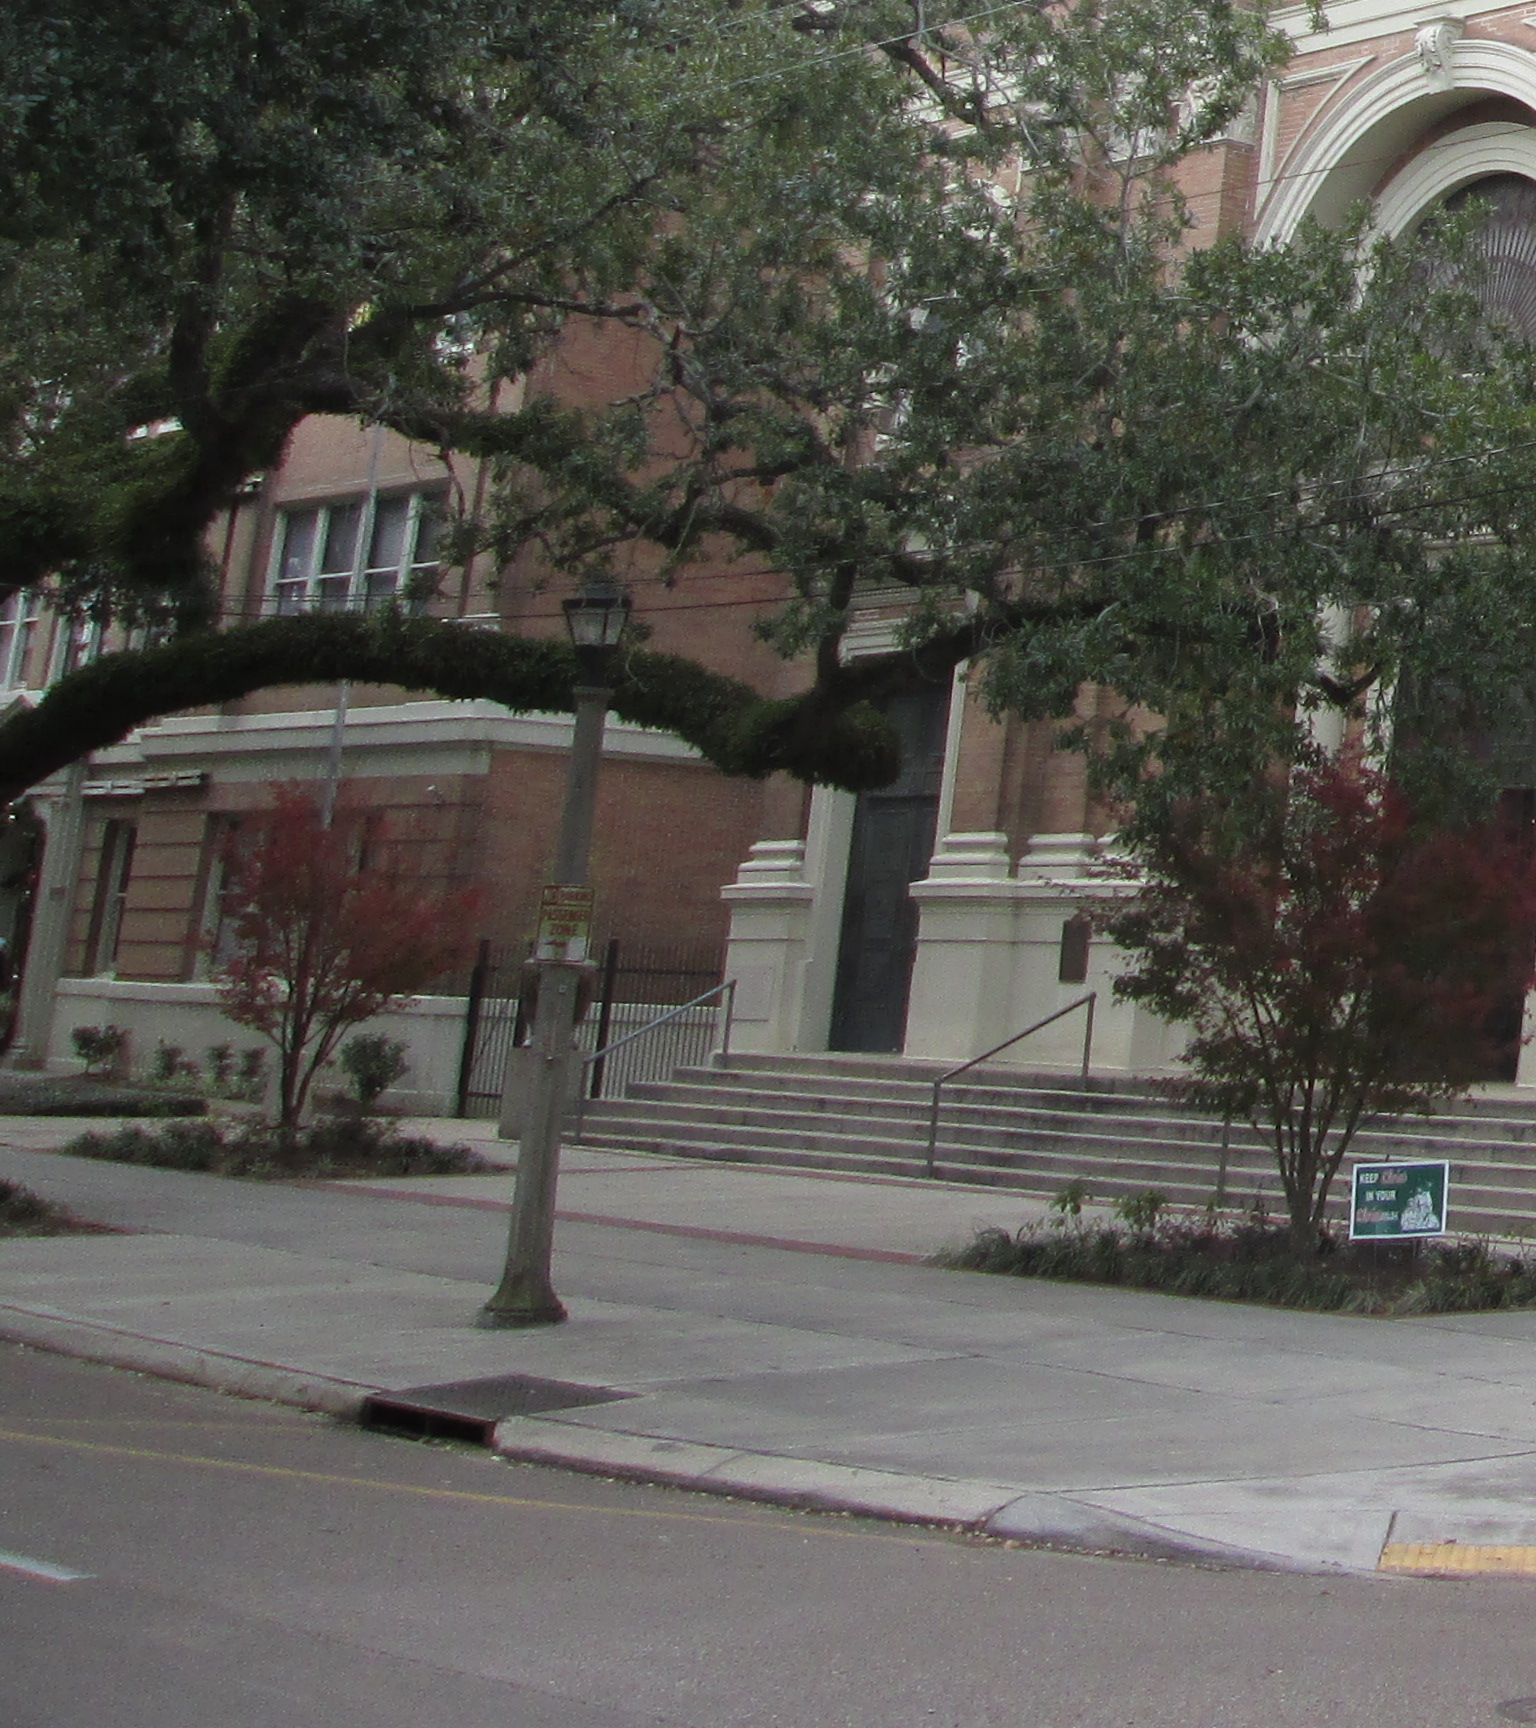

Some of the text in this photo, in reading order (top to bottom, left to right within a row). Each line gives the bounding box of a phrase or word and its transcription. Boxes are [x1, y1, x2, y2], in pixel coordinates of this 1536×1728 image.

[1359, 1172, 1379, 1184] KEEP
[1365, 1190, 1397, 1201] IN YOUR
